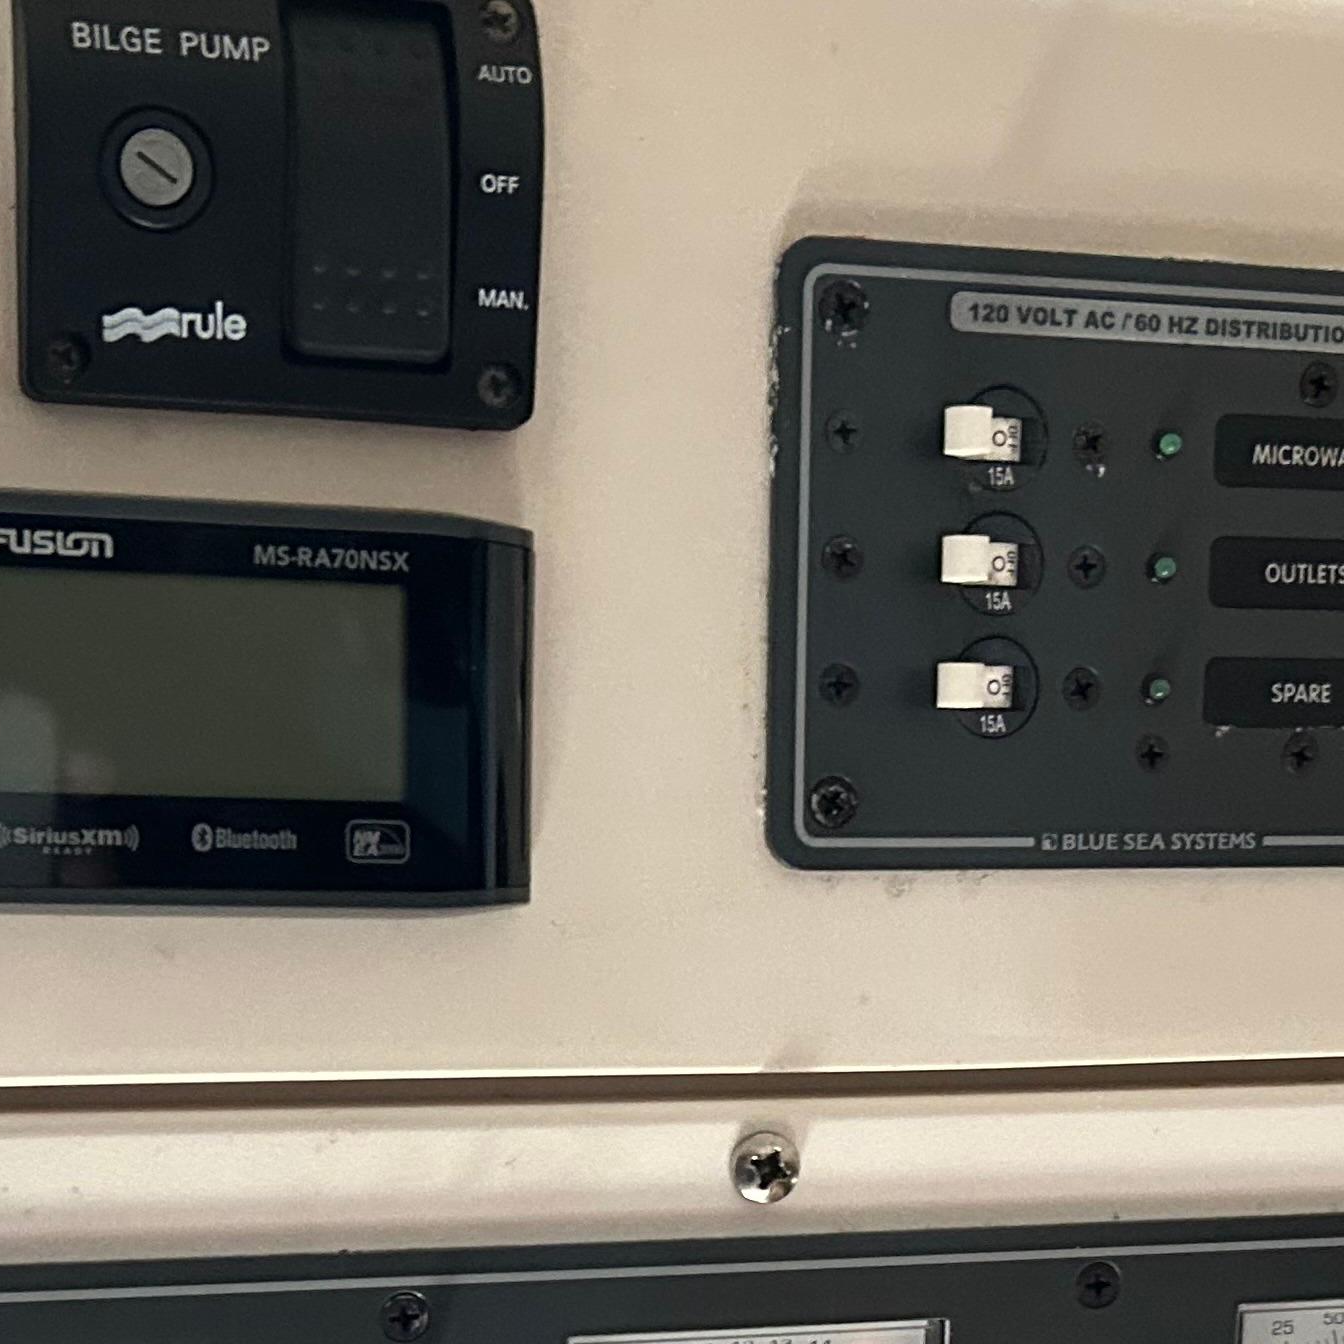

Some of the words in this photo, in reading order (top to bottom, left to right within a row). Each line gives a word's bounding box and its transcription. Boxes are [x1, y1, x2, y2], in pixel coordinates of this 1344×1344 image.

[72, 21, 163, 55] BILGE
[180, 30, 270, 62] PUMP
[478, 65, 532, 85] AUTO
[481, 174, 519, 194] OFF
[478, 288, 529, 310] MAN.
[181, 302, 247, 340] rule
[969, 303, 1011, 325] 120
[1017, 305, 1076, 329] VOLT
[1084, 309, 1118, 331] AC
[1134, 310, 1161, 332] 60
[1169, 313, 1200, 336] HZ
[988, 465, 1014, 485] 15A
[253, 545, 410, 572] MS-RA70NSX
[985, 591, 1012, 611] 15A
[1271, 682, 1332, 704] SPARE
[980, 714, 1006, 733] 15A
[215, 827, 297, 850] Bluetooth
[1062, 832, 1120, 852] BLUE
[1124, 832, 1164, 852] SEA
[1170, 832, 1256, 852] SYSTEMS
[1271, 1320, 1295, 1335] 25
